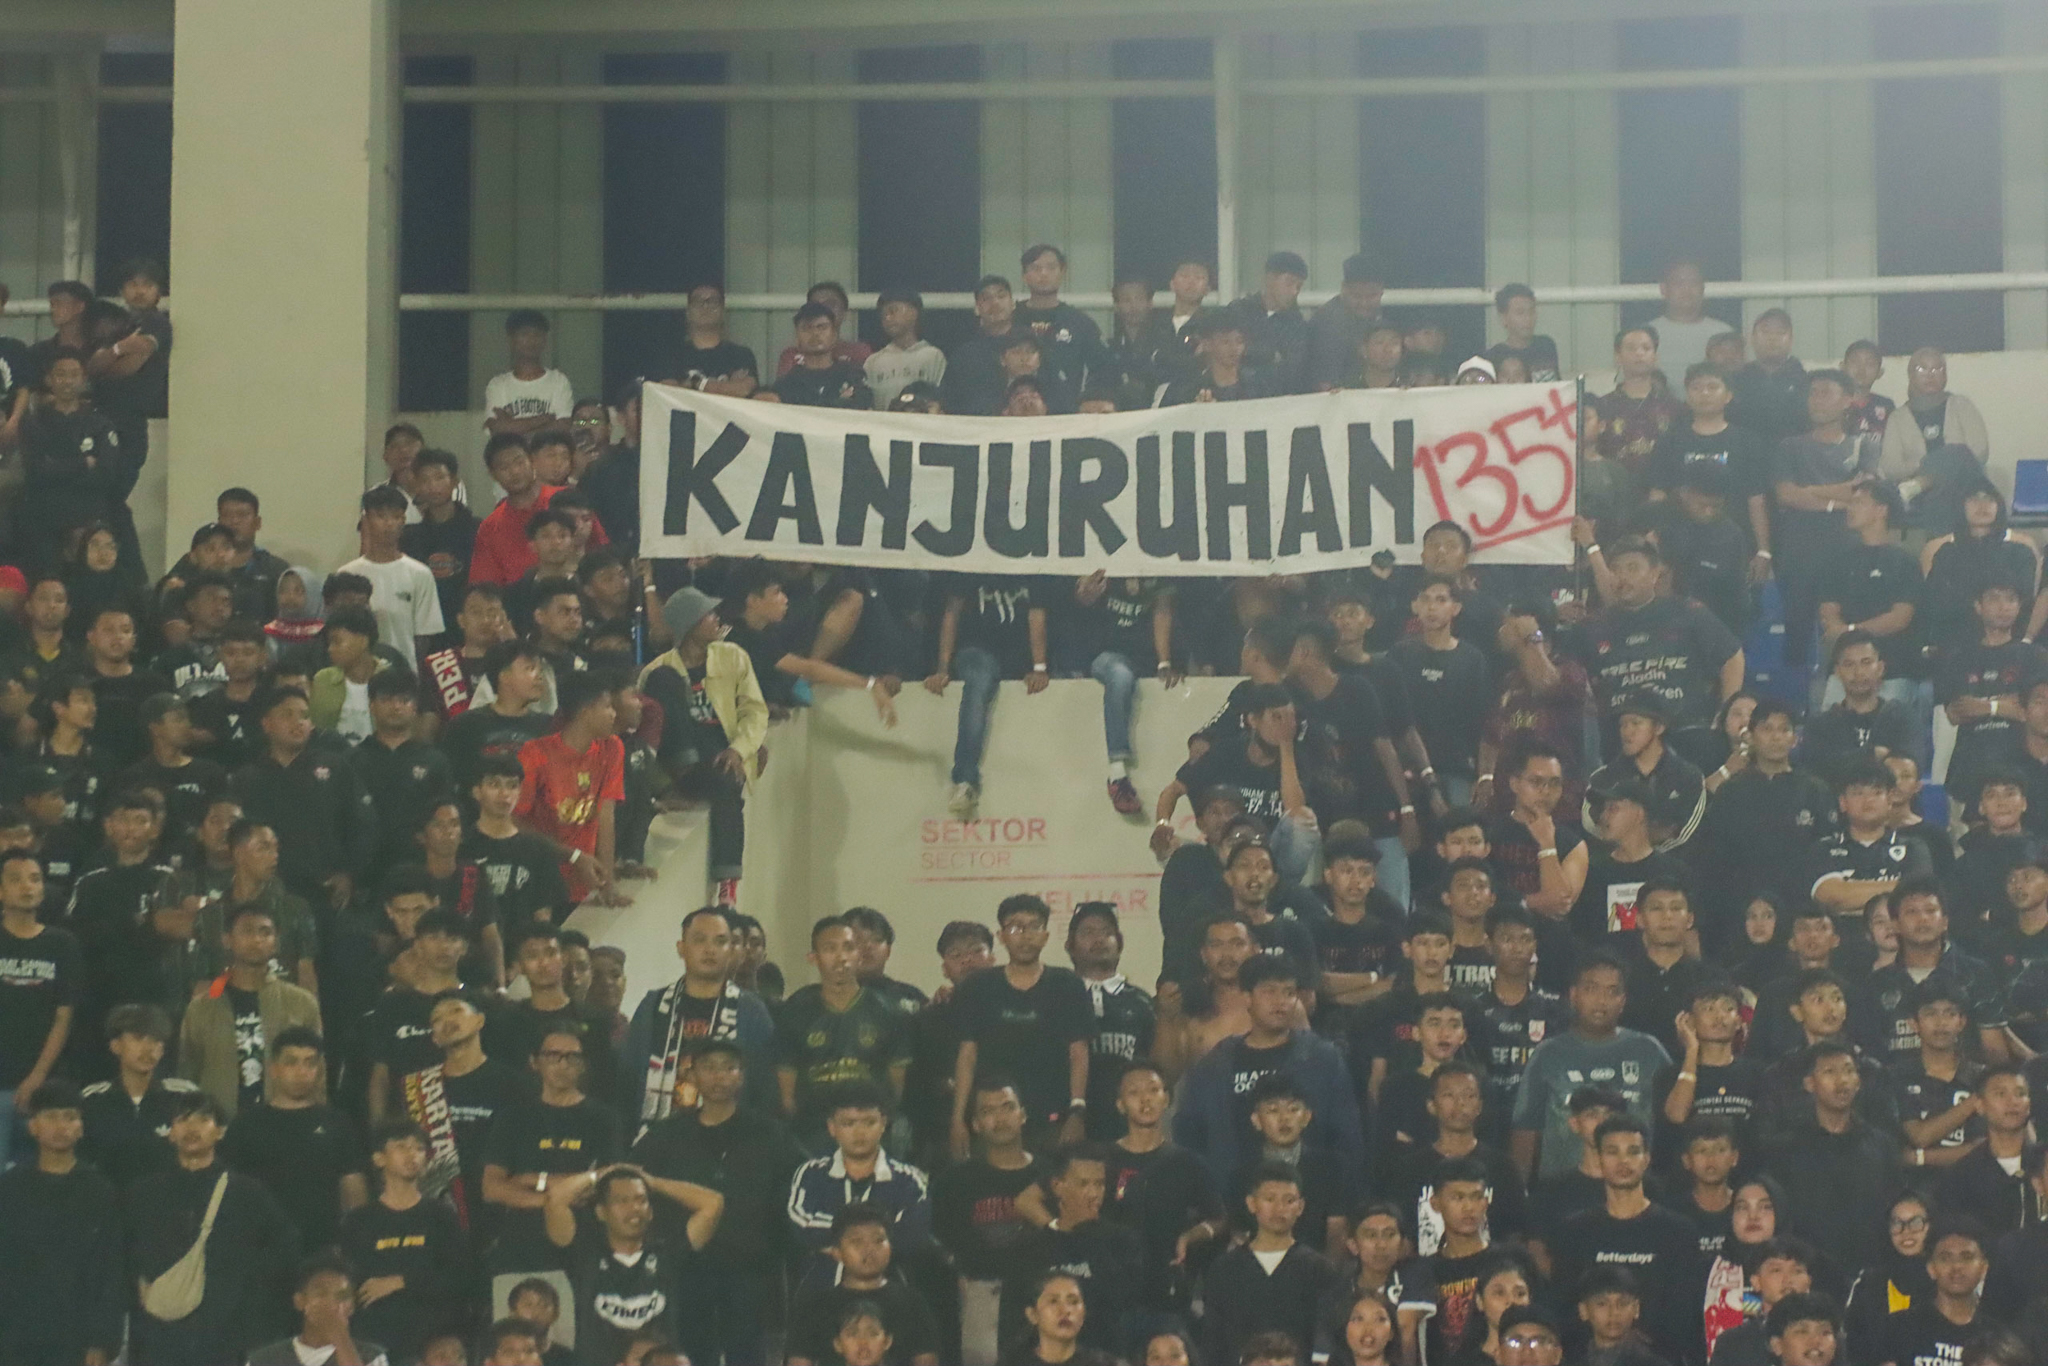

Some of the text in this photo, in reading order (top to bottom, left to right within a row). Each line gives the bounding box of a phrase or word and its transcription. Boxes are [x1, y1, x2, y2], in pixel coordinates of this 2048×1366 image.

[663, 409, 1415, 562] KANJURUHAN
[920, 817, 1048, 844] SEKTOR
[920, 850, 1012, 871] SECTOR
[1034, 889, 1148, 911] ELUAR
[1935, 1342, 1964, 1359] THE
